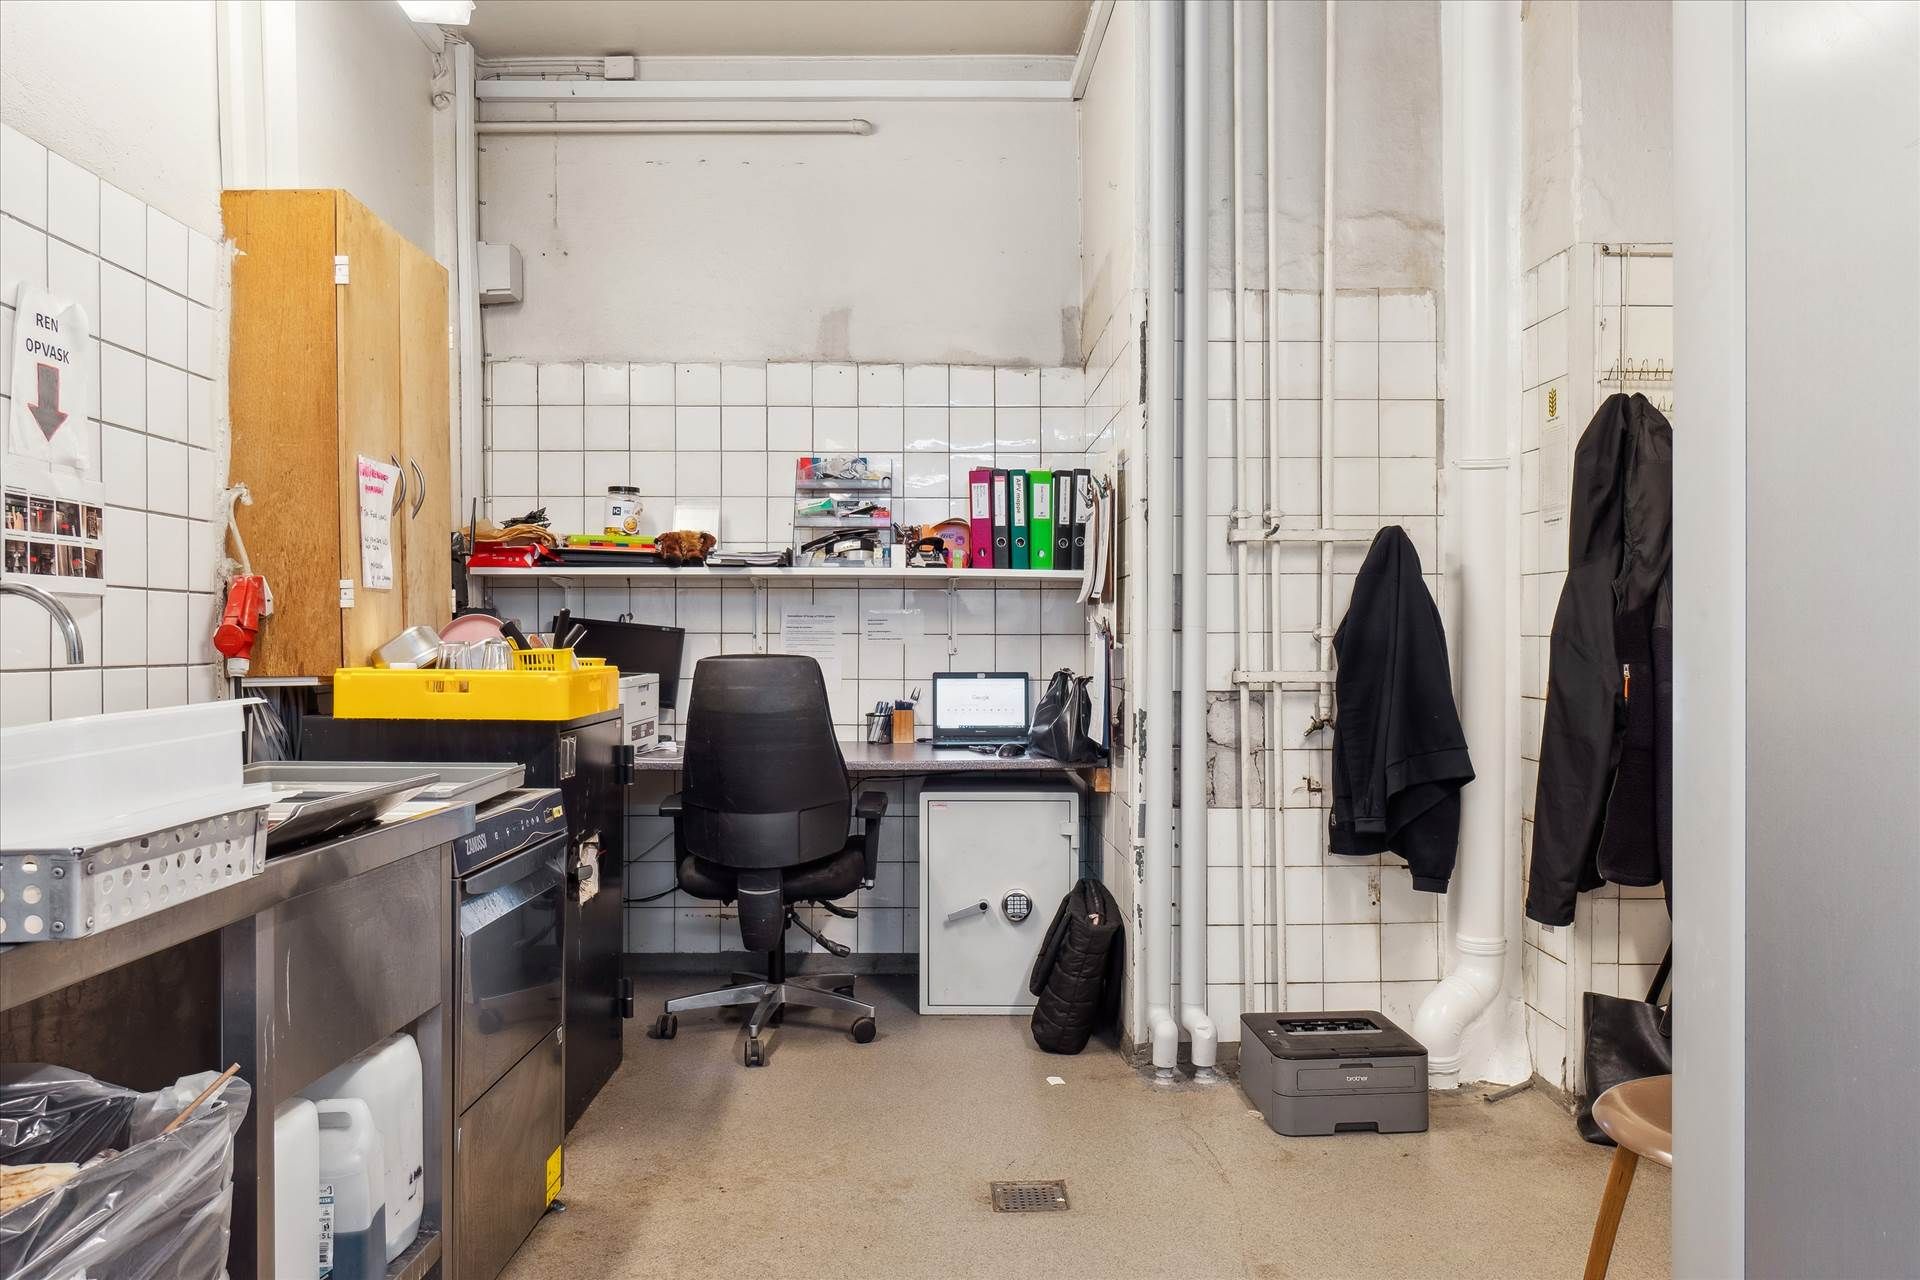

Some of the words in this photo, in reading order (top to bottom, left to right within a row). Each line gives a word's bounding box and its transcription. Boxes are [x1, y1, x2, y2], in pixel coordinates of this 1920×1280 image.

[36, 312, 59, 333] REN
[25, 337, 70, 365] OPVASK
[464, 832, 488, 856] ZANUSSI
